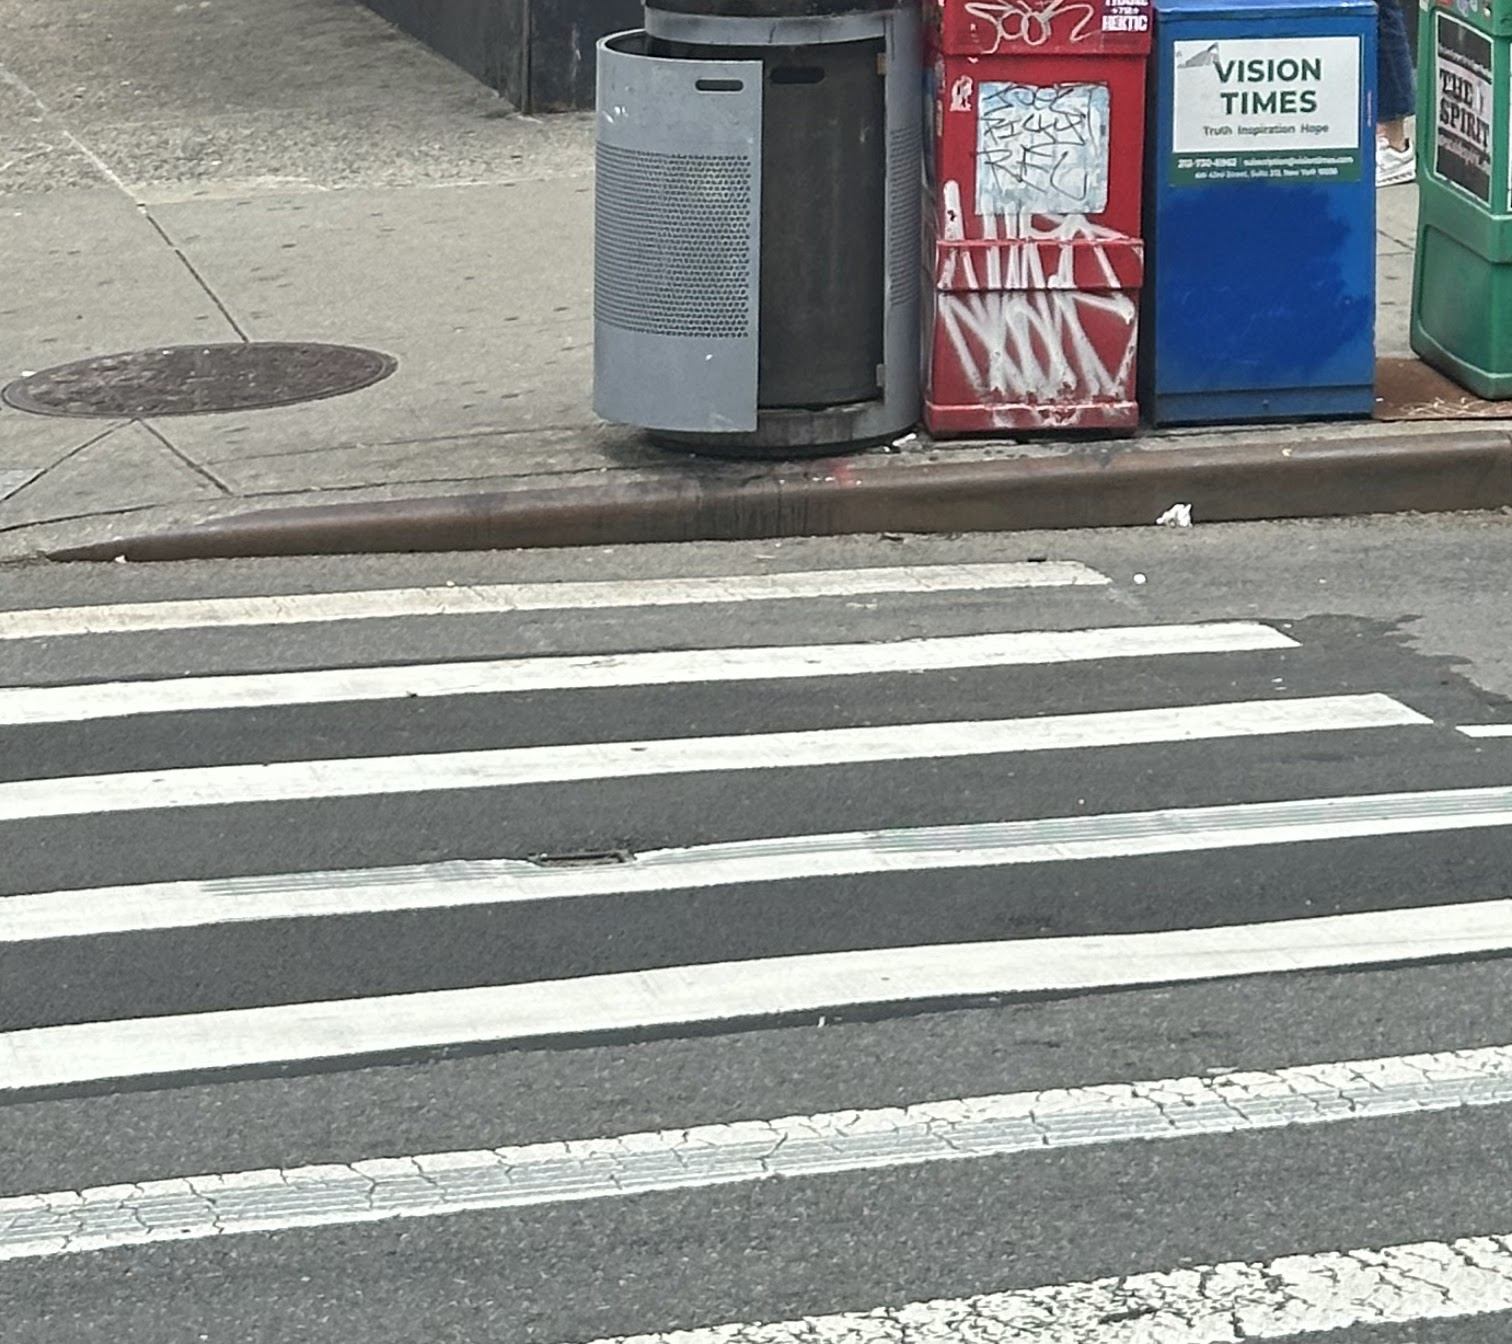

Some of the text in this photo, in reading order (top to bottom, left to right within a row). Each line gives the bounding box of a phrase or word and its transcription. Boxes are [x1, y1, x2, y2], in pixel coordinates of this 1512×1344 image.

[1213, 58, 1321, 83] VISION
[1440, 69, 1473, 109] THE
[1220, 90, 1317, 114] TIMES
[1203, 123, 1329, 137] Truth Inspiration Hope
[1440, 97, 1490, 148] SPIRIT
